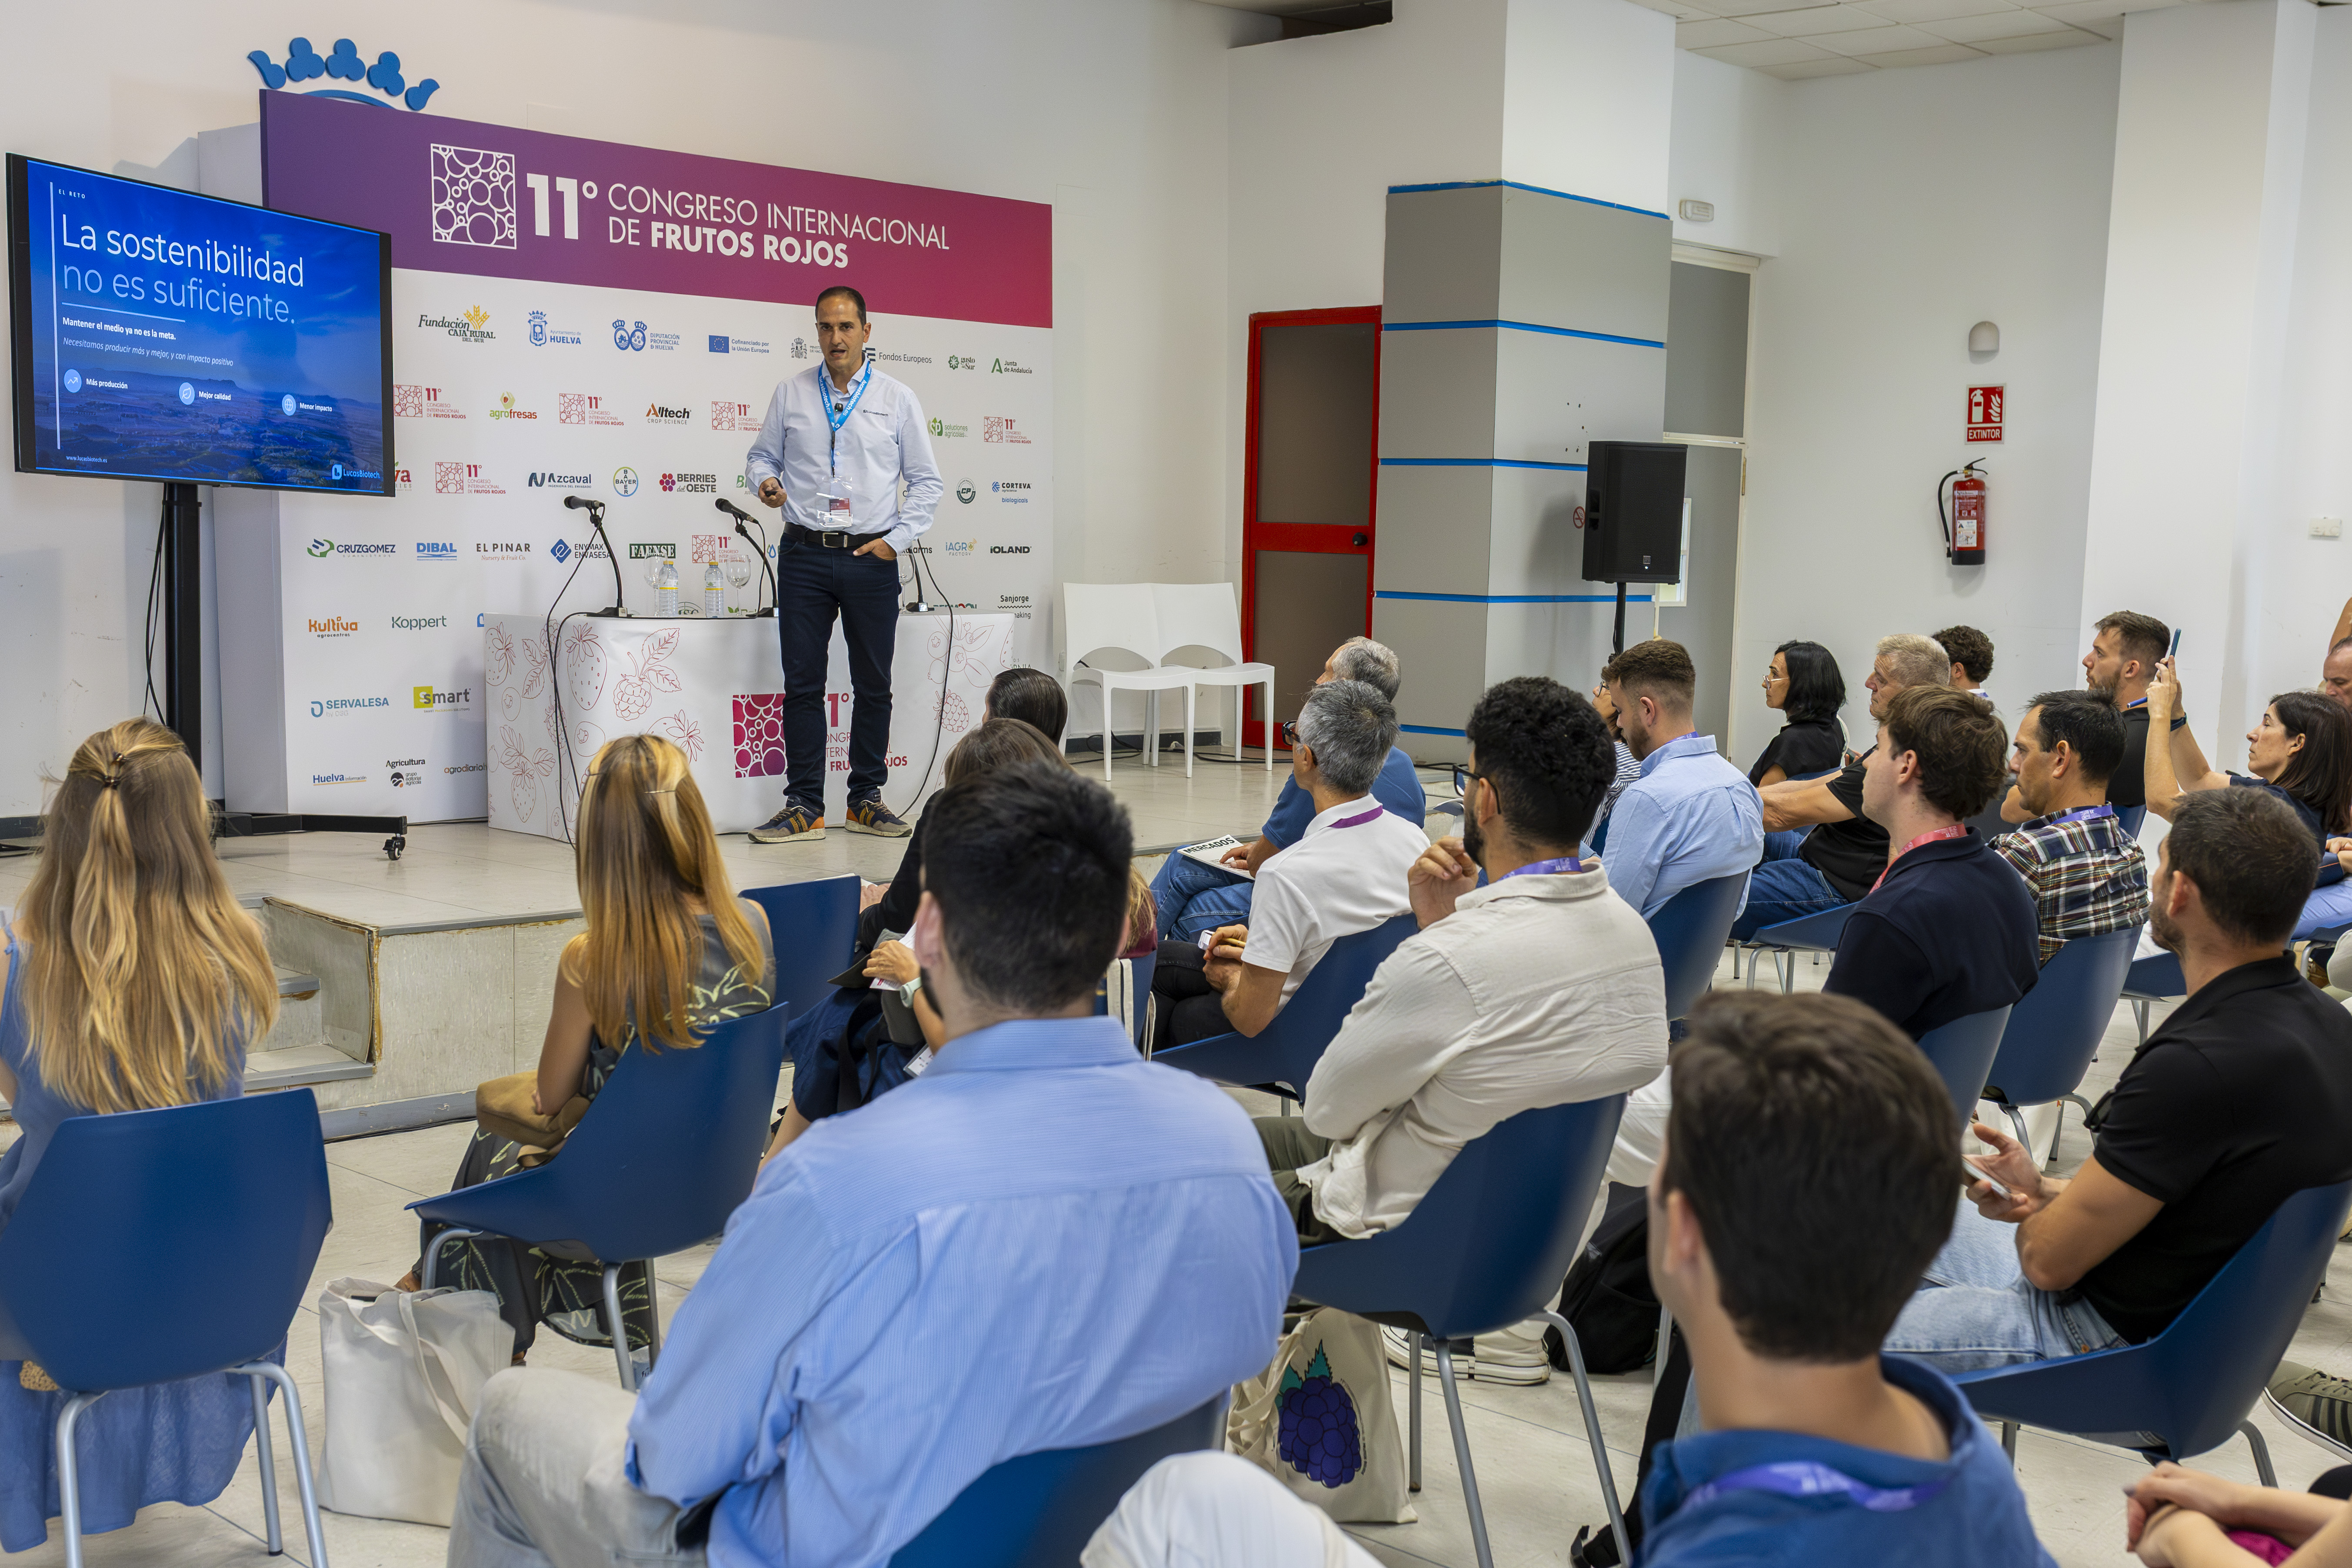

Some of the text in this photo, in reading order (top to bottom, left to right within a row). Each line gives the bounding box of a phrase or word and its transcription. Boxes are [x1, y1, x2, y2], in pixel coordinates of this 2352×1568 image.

[69, 190, 86, 199] RETO
[526, 173, 949, 250] 11° CONGRESO INTERNACIONAL
[609, 216, 849, 268] DE FRUTOS ROJOS
[63, 213, 304, 287] La sostenibilidad
[63, 264, 295, 323] no es suficiente.
[63, 317, 94, 329] Mantener
[97, 322, 102, 330] el
[104, 323, 123, 333] medio
[152, 329, 157, 337] la
[159, 332, 176, 340] meta.
[418, 314, 470, 331] Fundación
[448, 329, 496, 339] CAJA RURAL
[550, 336, 581, 345] HUELVA
[63, 337, 103, 350] Necesitamos
[105, 343, 130, 353] producir
[132, 346, 144, 355] más
[151, 350, 169, 359] mejor,
[187, 353, 210, 364] impacto
[212, 357, 233, 366] positivo
[879, 352, 932, 364] Fondos Europeos
[99, 380, 128, 389] producción
[425, 388, 442, 401] 11°
[588, 396, 602, 409] 11°
[490, 409, 537, 420] agrofresas
[646, 403, 690, 419] Alltech
[737, 404, 750, 416] 11°
[1005, 419, 1016, 430] 11°
[1969, 429, 2000, 439] EXTINTOR
[66, 455, 107, 464] www.lucasbiotech.es
[343, 469, 380, 478] LucasBiotech
[466, 465, 482, 477] 11°
[548, 473, 591, 484] Azcaval
[677, 473, 716, 483] BERRIES
[686, 483, 716, 493] OESTE
[416, 543, 457, 553] DIBAL
[476, 543, 531, 552] EL PINAR
[718, 536, 731, 548] 11°
[336, 544, 396, 553] CRUZGOMEZ
[630, 545, 674, 557] FAENSE
[1000, 595, 1029, 603] Sanjorge
[309, 616, 358, 633] Kultiva
[392, 616, 447, 630] Koppert
[326, 697, 389, 709] SERVALESA
[828, 692, 849, 727] 1°
[386, 759, 425, 769] Agricultura
[313, 774, 344, 783] Huelva
[1183, 837, 1235, 854] MERCADOS
